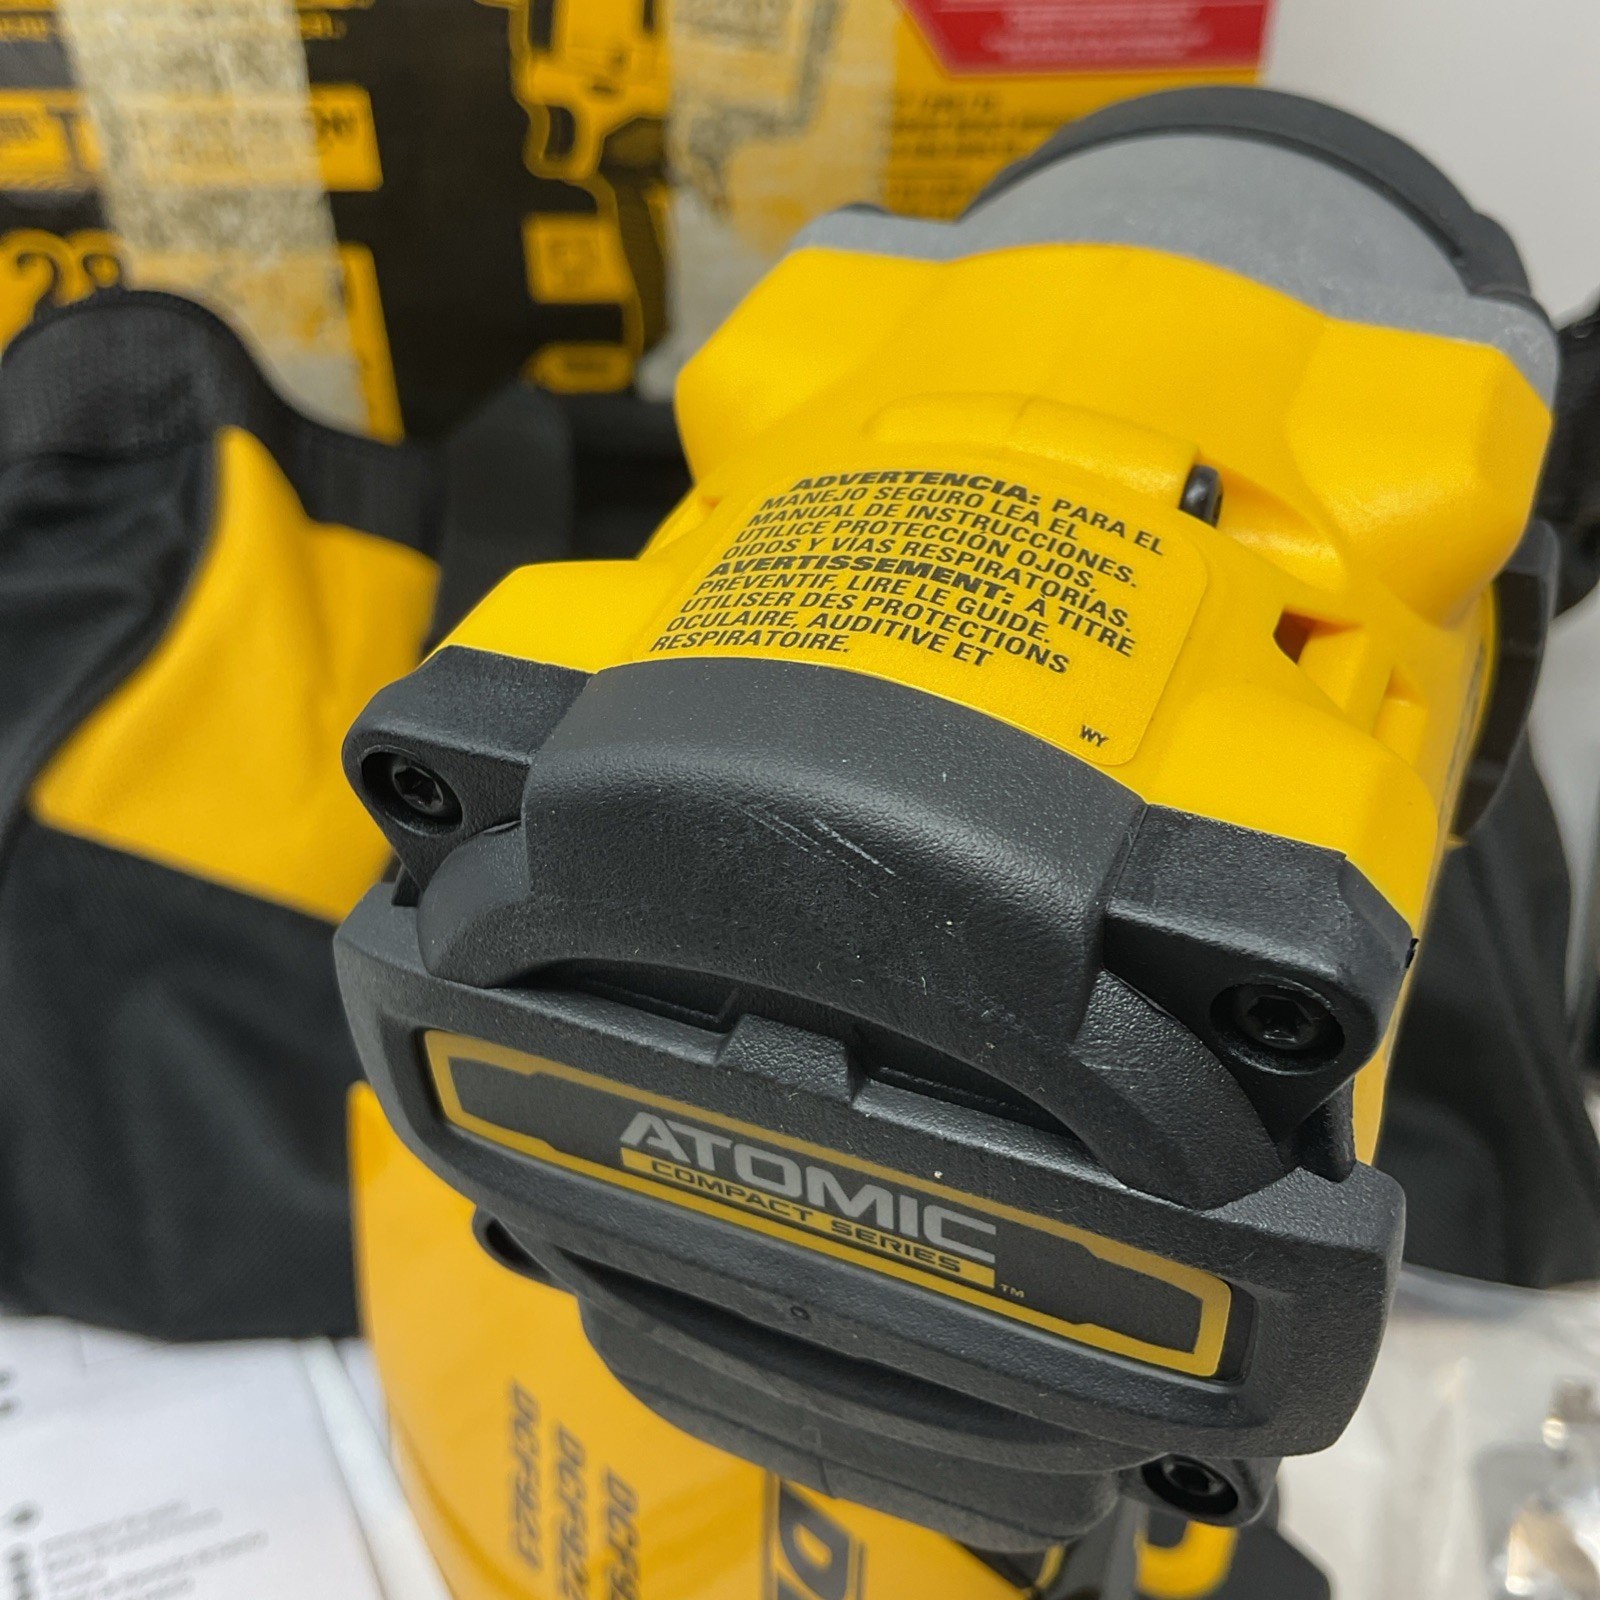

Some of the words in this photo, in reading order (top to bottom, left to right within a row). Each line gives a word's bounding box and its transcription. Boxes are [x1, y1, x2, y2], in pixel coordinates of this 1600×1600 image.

[748, 503, 856, 527] MANUAL
[863, 503, 903, 518] DE
[905, 504, 1137, 588] INSTRUCCIONES.
[761, 487, 869, 511] MANEJO
[874, 487, 984, 508] SEGURO
[990, 500, 1040, 527] LEA
[1049, 518, 1079, 541] EL
[790, 471, 1042, 506] ADVERTENCIA:
[1051, 499, 1126, 538] PARA
[1134, 530, 1164, 556] EL
[808, 538, 826, 552] Y
[831, 531, 896, 553] VÍAS
[735, 520, 830, 543] UTILICE
[832, 520, 1011, 559] PROTECCIÓN
[1017, 549, 1097, 594] OJOS,
[650, 629, 851, 653] RESPIRATOIRE.
[666, 610, 799, 632] OCULAIRE,
[807, 613, 949, 653] AUDITIVE
[952, 642, 995, 667] ET
[680, 592, 796, 614] UTILISER
[799, 592, 858, 611] DES
[862, 596, 1070, 674] PROTECTIONS
[693, 572, 838, 595] PRÉVENTIF,
[846, 574, 911, 596] LIRE
[914, 583, 951, 607] LE
[955, 596, 1050, 643] GUIDE.
[705, 555, 1015, 605] AVERTISSEMENT:
[1025, 593, 1046, 618] À
[1057, 606, 1136, 658] TITRE
[1079, 724, 1110, 748] WY
[620, 1111, 996, 1264] ATOMIC
[652, 1160, 813, 1222] COMPACT
[831, 1219, 960, 1273] SERIES
